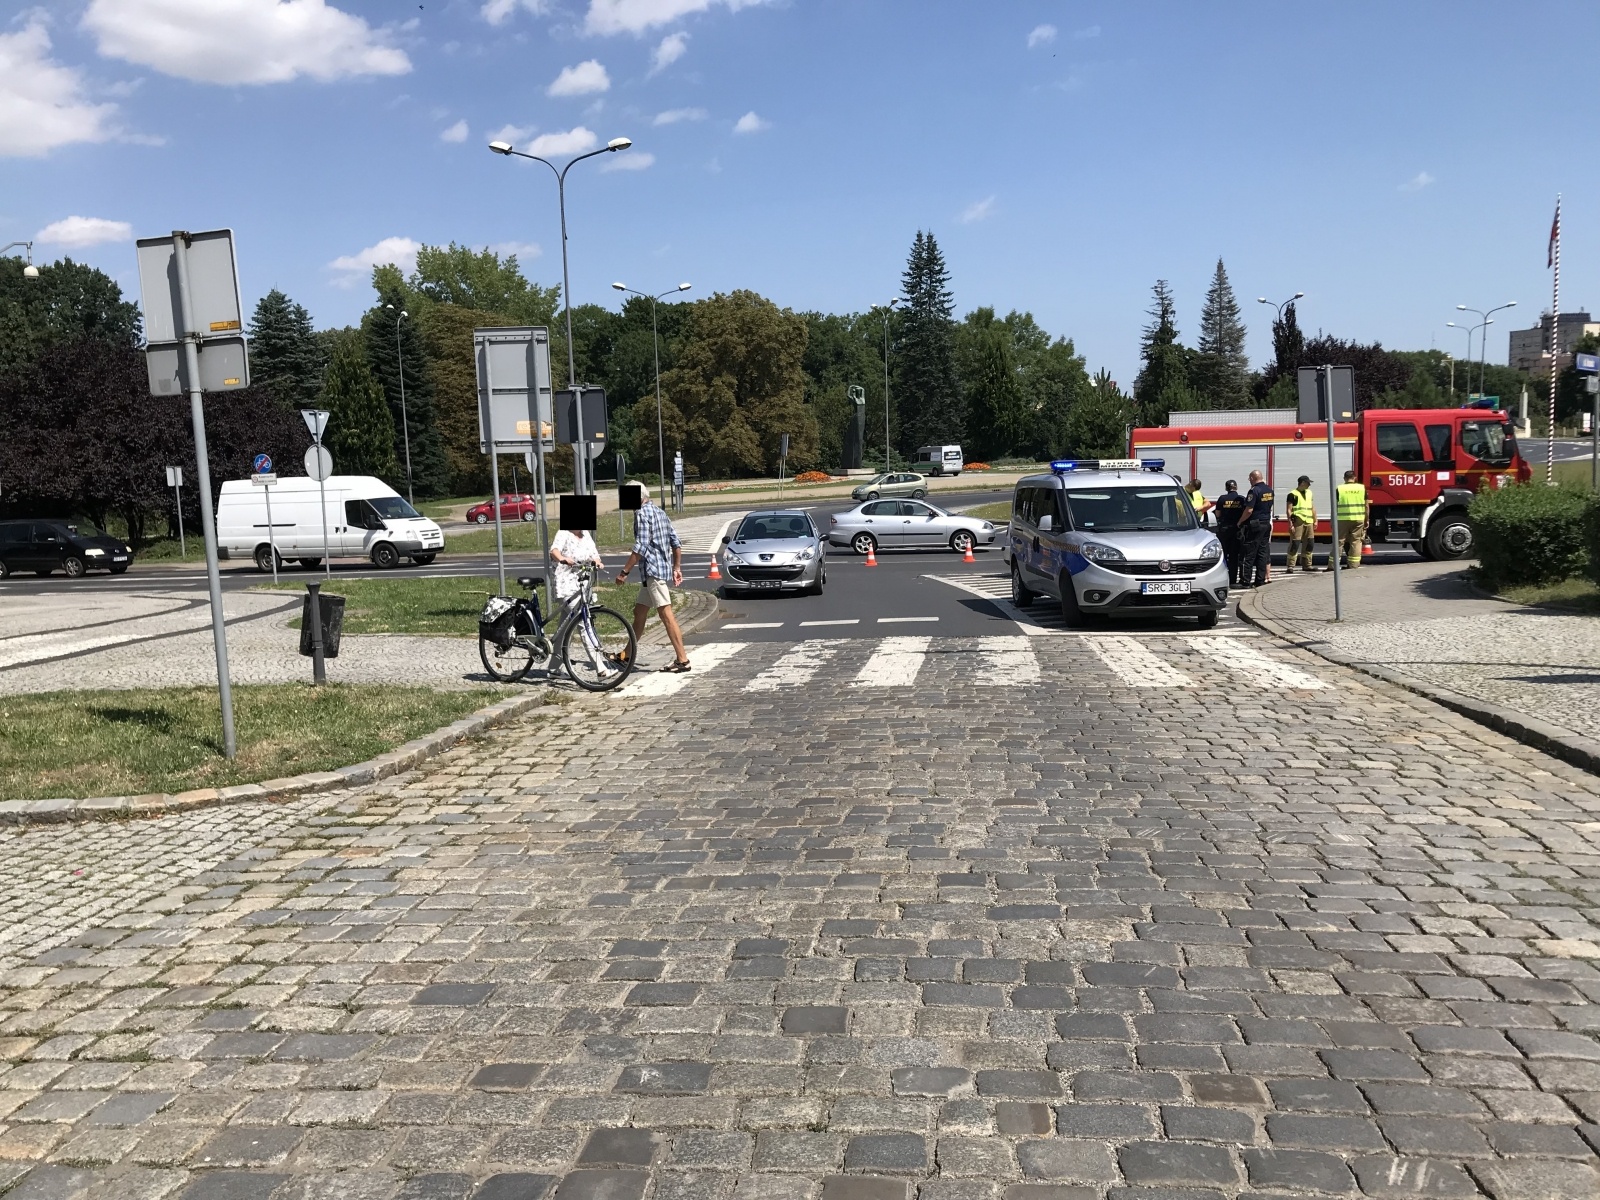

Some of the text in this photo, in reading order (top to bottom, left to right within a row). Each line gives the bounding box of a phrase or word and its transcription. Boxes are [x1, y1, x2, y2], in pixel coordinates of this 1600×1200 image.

[1389, 474, 1407, 486] 561
[1414, 474, 1426, 486] 21
[1147, 583, 1166, 593] SRC
[1168, 583, 1190, 592] 3GL3
